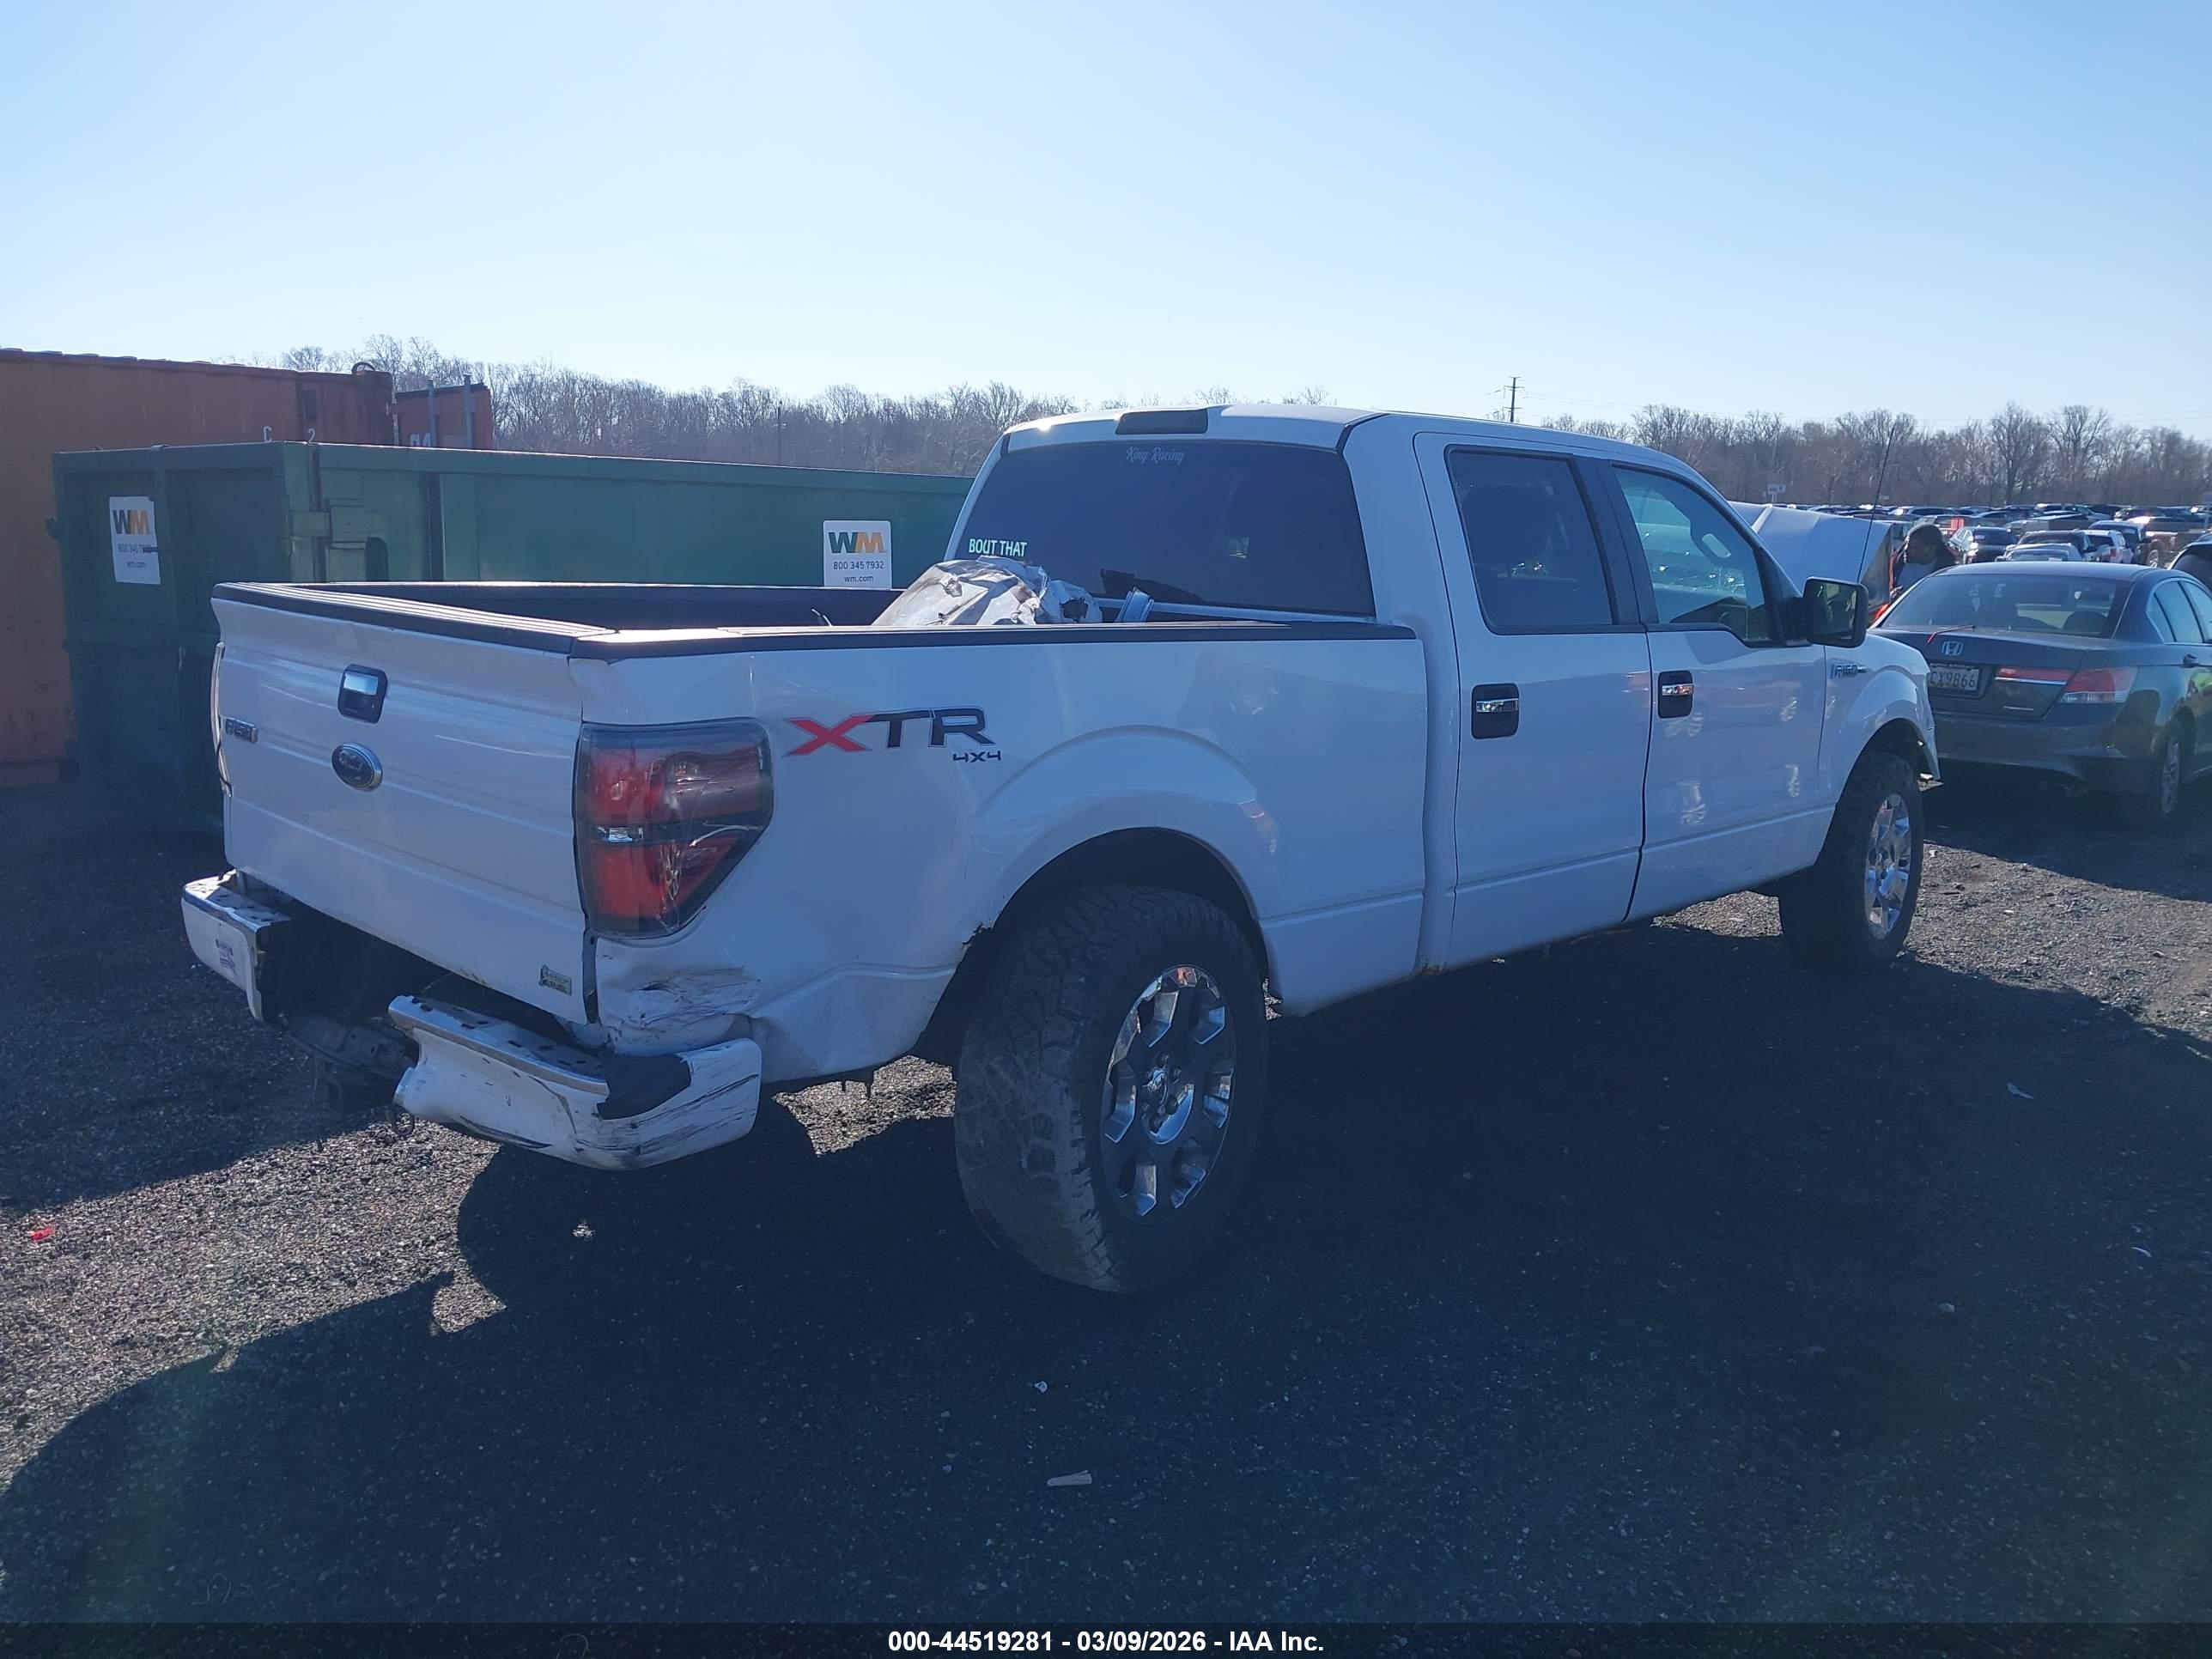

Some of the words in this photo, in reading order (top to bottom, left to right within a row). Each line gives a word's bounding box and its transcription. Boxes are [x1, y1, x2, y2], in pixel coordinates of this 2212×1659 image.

[1151, 446, 1185, 465] Racing
[112, 509, 149, 534] WM
[828, 532, 885, 553] WM
[969, 538, 998, 555] BOUT
[999, 540, 1028, 557] THAT
[833, 561, 848, 570] 800
[850, 561, 865, 570] 345
[866, 560, 884, 569] 7932
[781, 706, 996, 758] XTR
